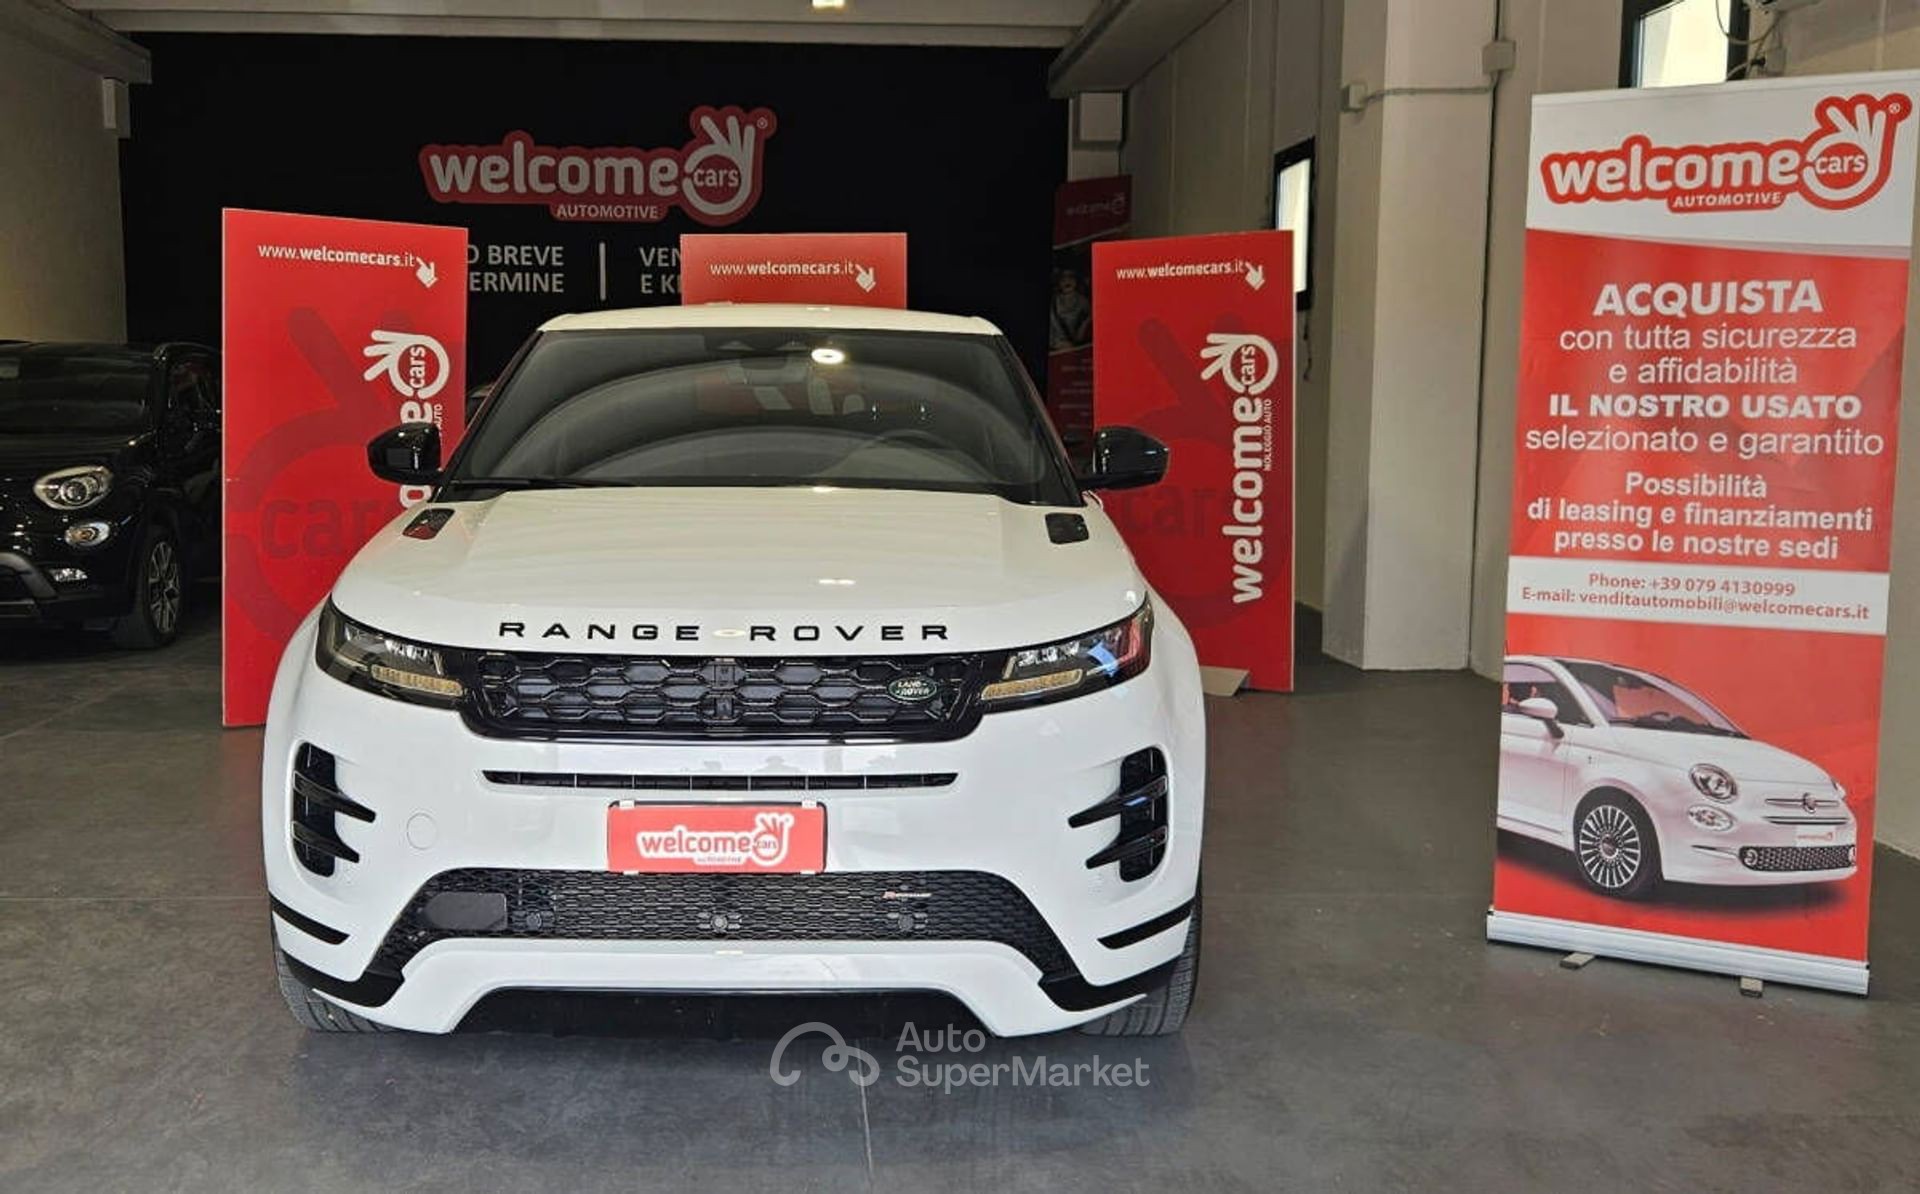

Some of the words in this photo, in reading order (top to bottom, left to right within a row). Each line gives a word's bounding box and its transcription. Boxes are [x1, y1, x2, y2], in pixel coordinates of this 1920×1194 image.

[430, 140, 679, 195] welcome
[693, 165, 740, 189] cars
[1552, 145, 1798, 195] welcome
[1813, 153, 1866, 176] cars
[556, 204, 658, 220] AUTOMOTIVE
[1672, 192, 1783, 208] AUTOMOTIVE
[259, 244, 415, 267] www.welcomecars.it
[487, 244, 564, 267] BREVE
[711, 261, 854, 276] www.welcomecars.it
[1117, 263, 1243, 280] www.welcomecars.it
[469, 272, 564, 294] ERMINE
[641, 275, 653, 294] E
[1593, 280, 1823, 318] ACQUISTA
[1560, 329, 1612, 350] con
[1624, 325, 1690, 349] tutta
[1702, 323, 1857, 348] sicurezza
[410, 346, 425, 388] cars
[1241, 345, 1255, 385] cars
[1609, 366, 1627, 384] e
[1638, 358, 1796, 384] affidabilità
[1263, 399, 1272, 424] AUTO
[1549, 394, 1578, 417] IL
[1590, 395, 1729, 418] NOSTRO
[1742, 396, 1862, 419] USATO
[1526, 426, 1698, 452] selezionato
[1709, 433, 1728, 452] e
[1739, 430, 1884, 459] garantito
[1626, 472, 1767, 498] Possibilità
[1223, 396, 1263, 603] welcome
[1528, 498, 1550, 520] di
[1559, 500, 1652, 528] leasing
[1661, 507, 1676, 524] e
[1684, 502, 1873, 532] finanziamenti
[1554, 531, 1642, 554] presso
[1652, 531, 1674, 552] le
[1683, 537, 1769, 557] nostre
[1779, 536, 1839, 559] sedi
[1589, 573, 1645, 590] Phone:
[1651, 575, 1681, 592] +39
[1685, 577, 1716, 593] 079
[1720, 578, 1796, 597] 4130999
[1522, 587, 1575, 604] E-mail:
[1579, 592, 1869, 620] venditautomobili@welcomecars.it
[499, 622, 700, 641] RANGE
[749, 625, 949, 641] ROVER
[642, 830, 751, 853] welcome
